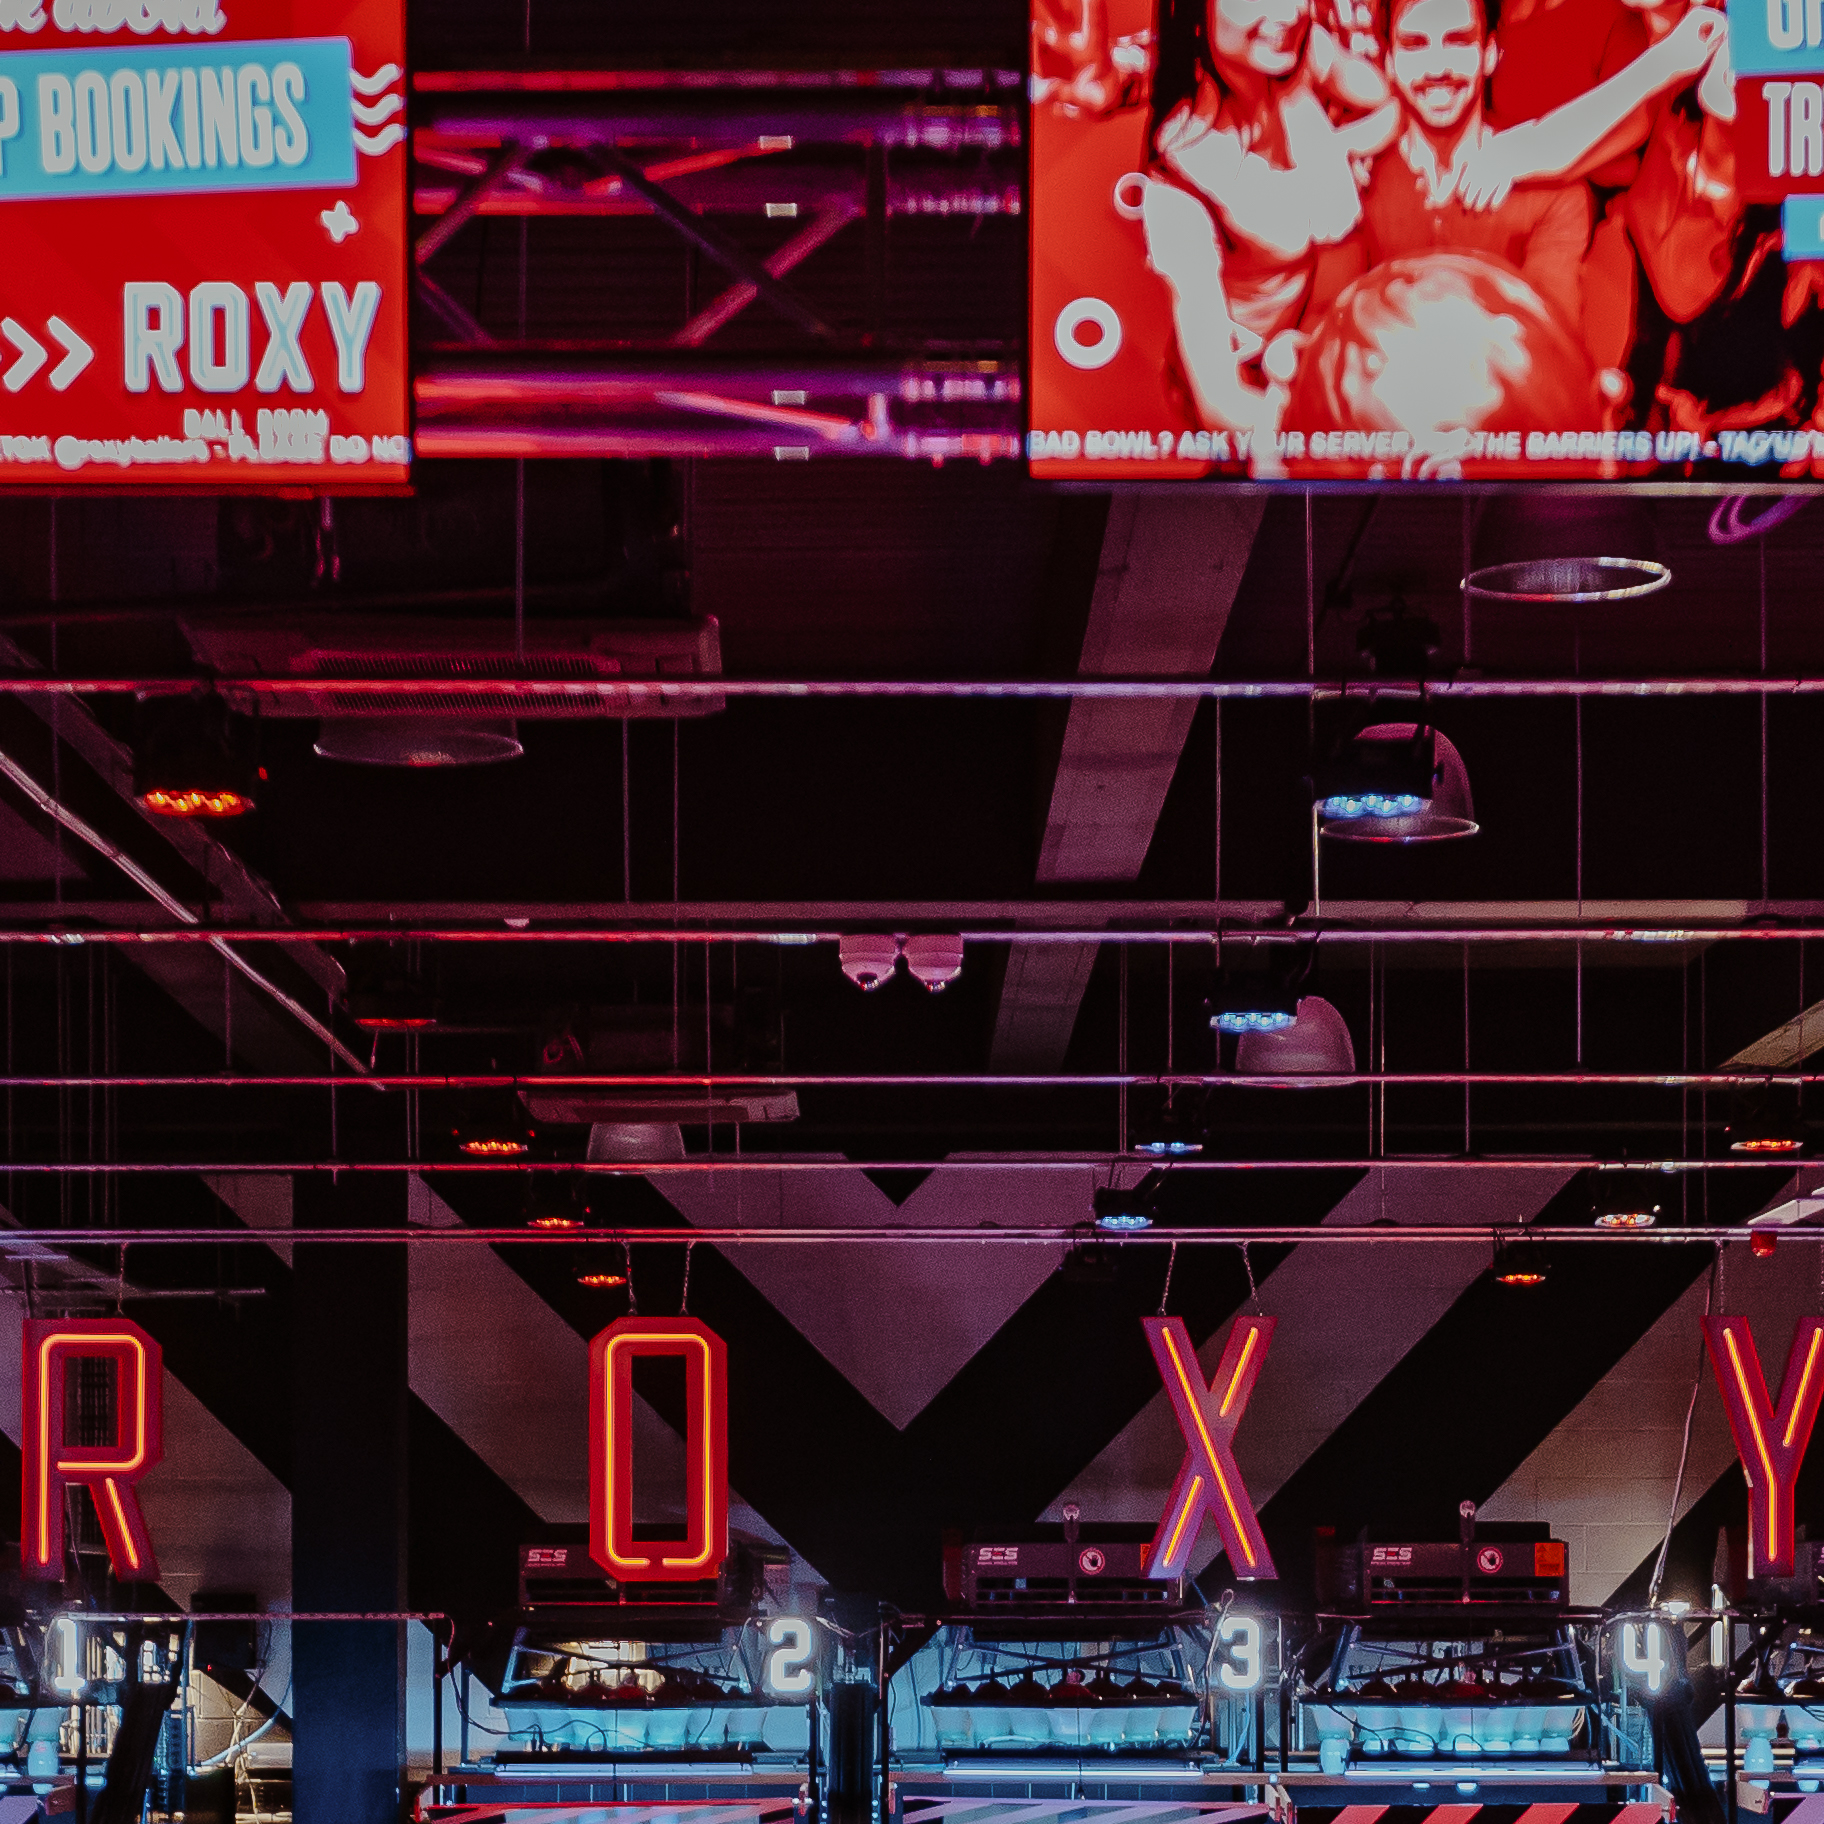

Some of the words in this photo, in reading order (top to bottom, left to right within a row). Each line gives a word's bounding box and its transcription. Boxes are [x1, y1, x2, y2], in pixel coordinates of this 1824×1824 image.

[37, 62, 309, 174] BOOKINGS
[123, 281, 381, 393] ROXY
[1029, 431, 1081, 459] BAD
[1083, 431, 1174, 459] BOWL?
[1177, 431, 1229, 459] ASK
[1234, 432, 1305, 459] YUR
[1473, 431, 1521, 460] THE
[1525, 431, 1653, 460] BARRIERS
[53, 1616, 85, 1692] 1
[769, 1617, 813, 1692] 2
[1220, 1616, 1261, 1690] 3
[1622, 1622, 1664, 1691] 4
